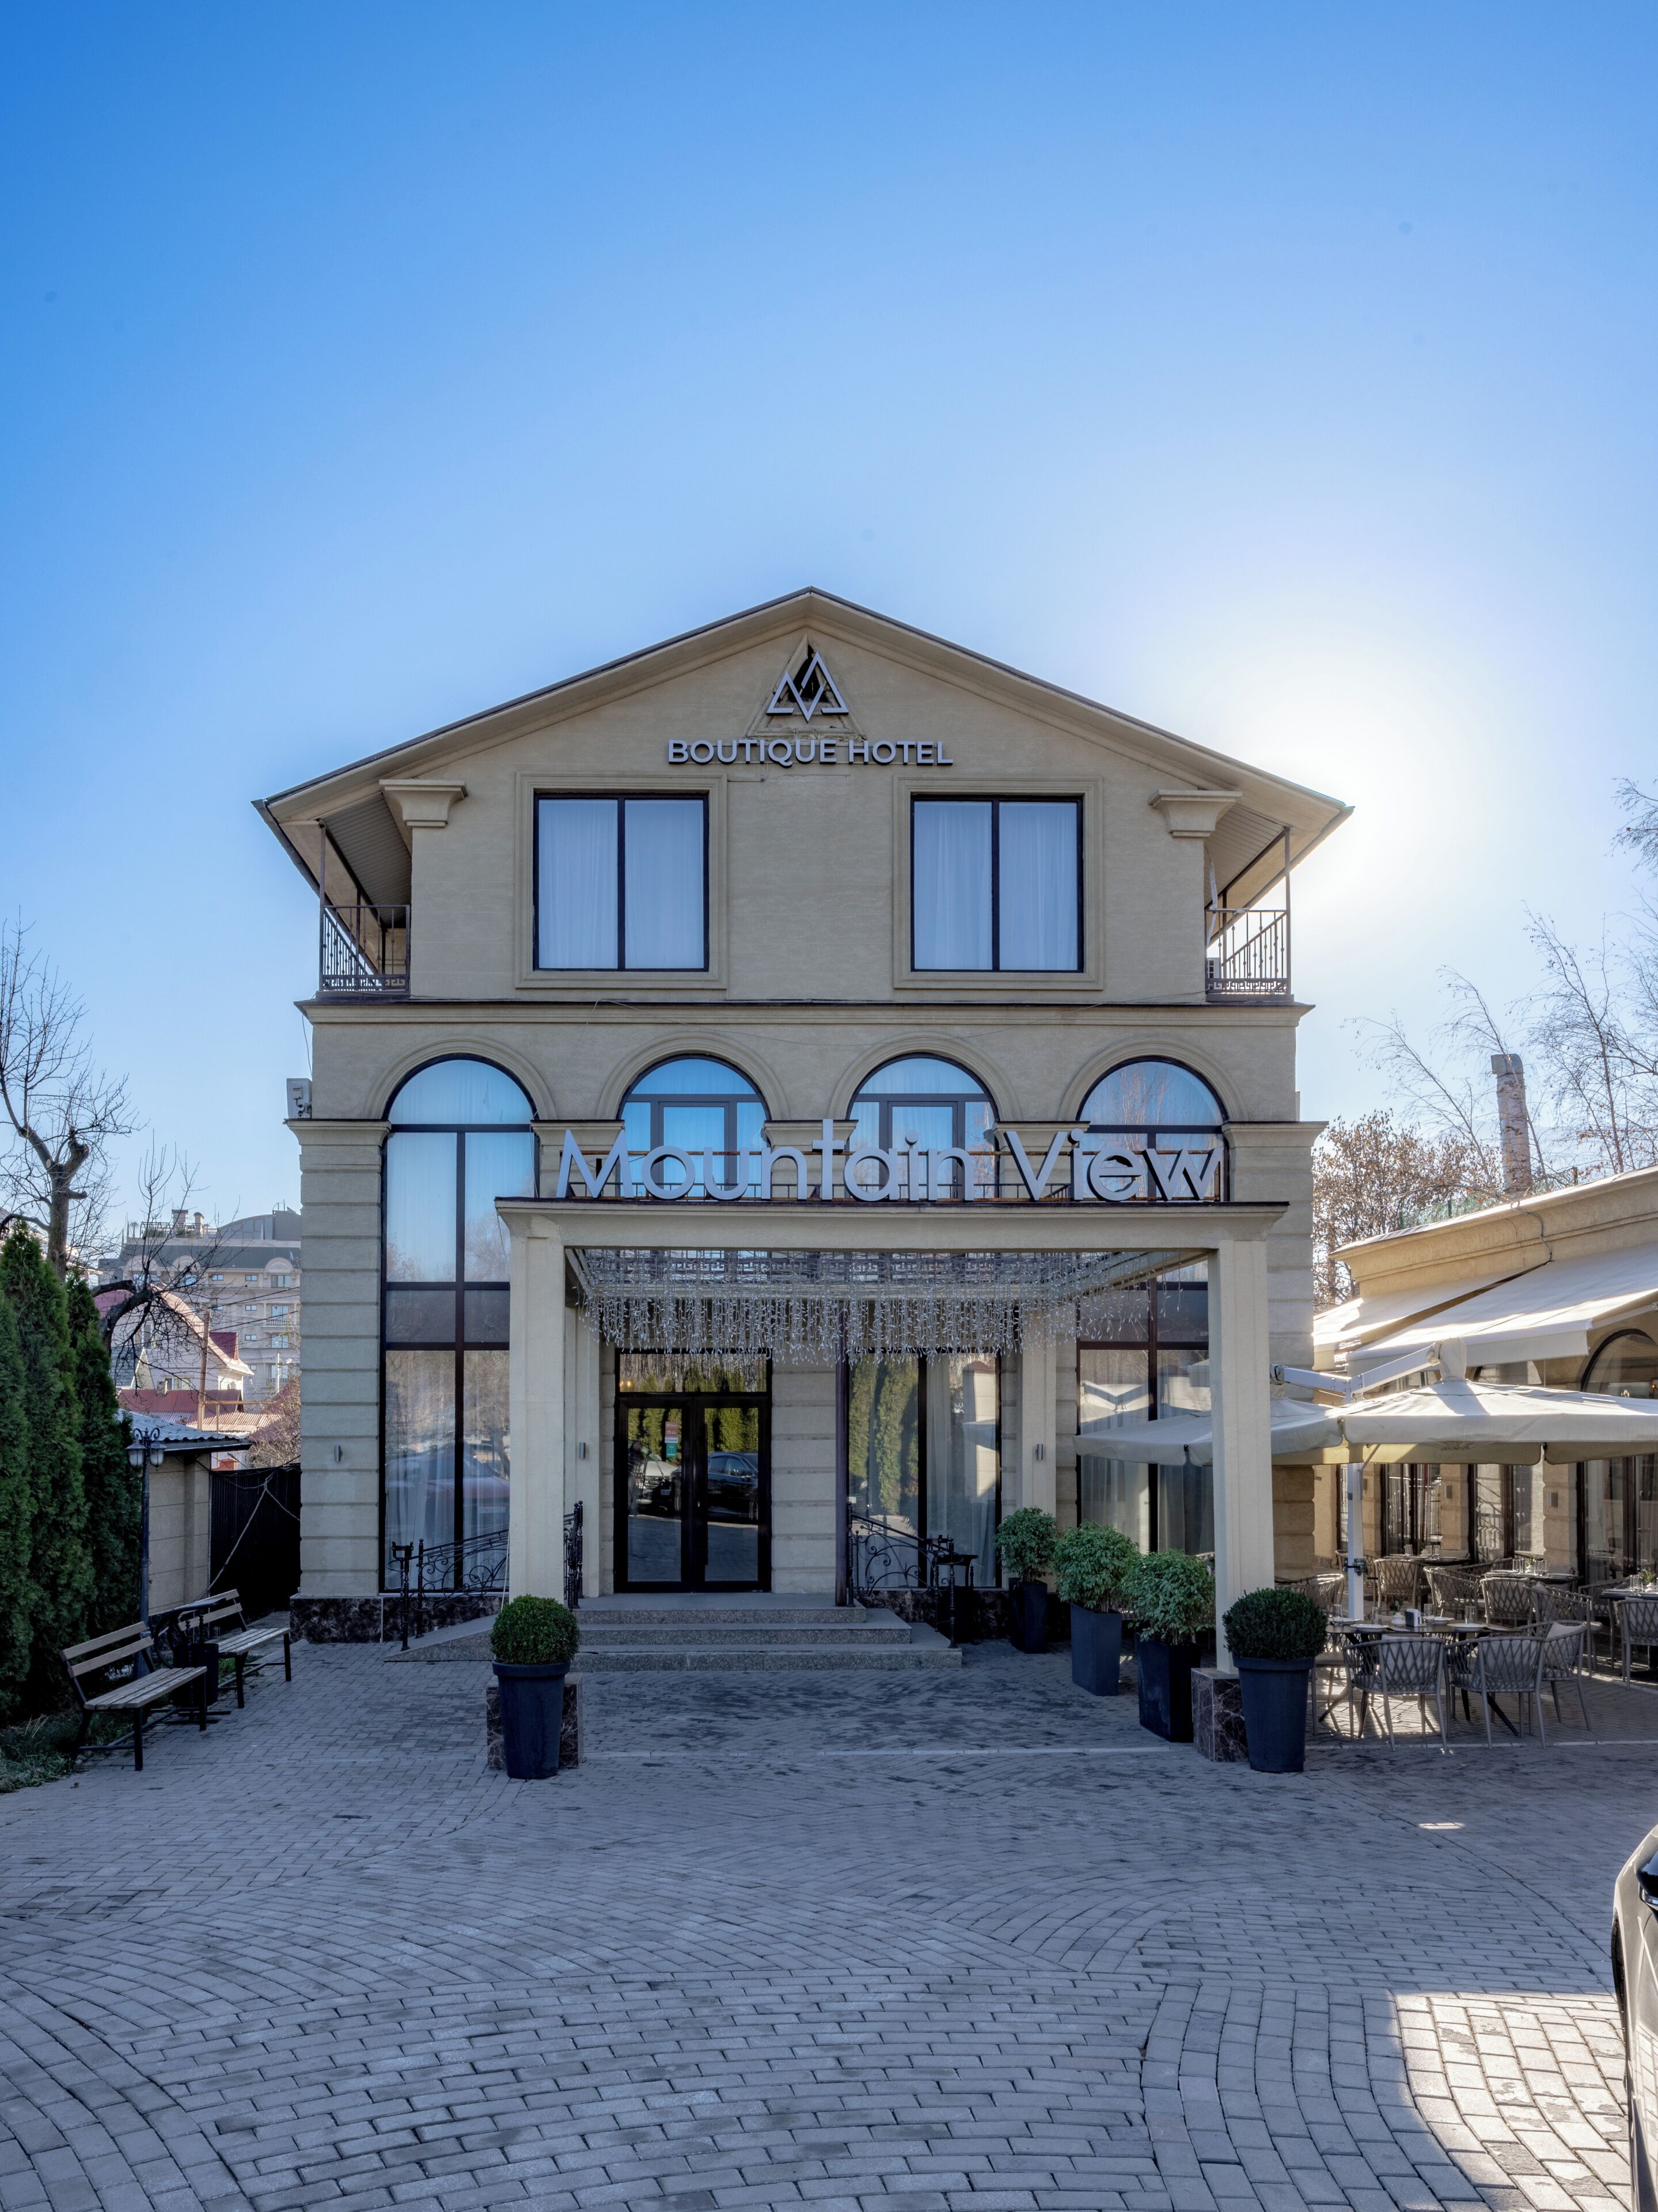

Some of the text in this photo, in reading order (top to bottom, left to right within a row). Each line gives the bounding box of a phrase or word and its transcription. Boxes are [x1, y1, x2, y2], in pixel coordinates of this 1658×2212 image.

[669, 739, 954, 768] BOUTIQUE HOTEL
[556, 1119, 1224, 1202] Mountain View
